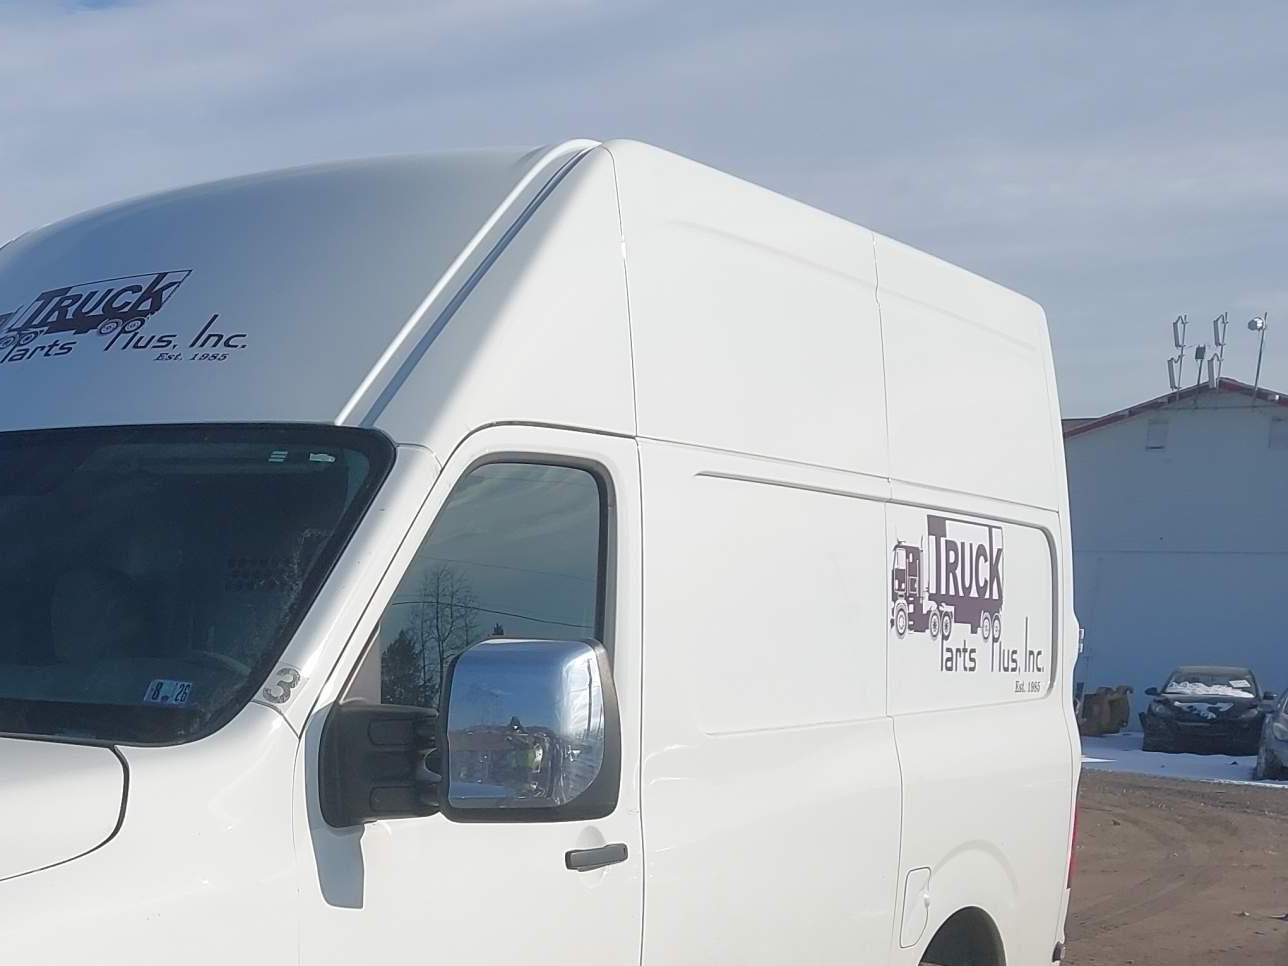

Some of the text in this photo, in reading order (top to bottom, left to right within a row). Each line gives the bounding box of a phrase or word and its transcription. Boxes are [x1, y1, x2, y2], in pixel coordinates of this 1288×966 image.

[21, 272, 182, 328] TRUCK
[188, 314, 248, 349] Inc.
[154, 352, 229, 361] Est. 1985
[927, 515, 1003, 600] TRUCK
[1024, 616, 1045, 673] Inc.
[263, 668, 301, 703] 3
